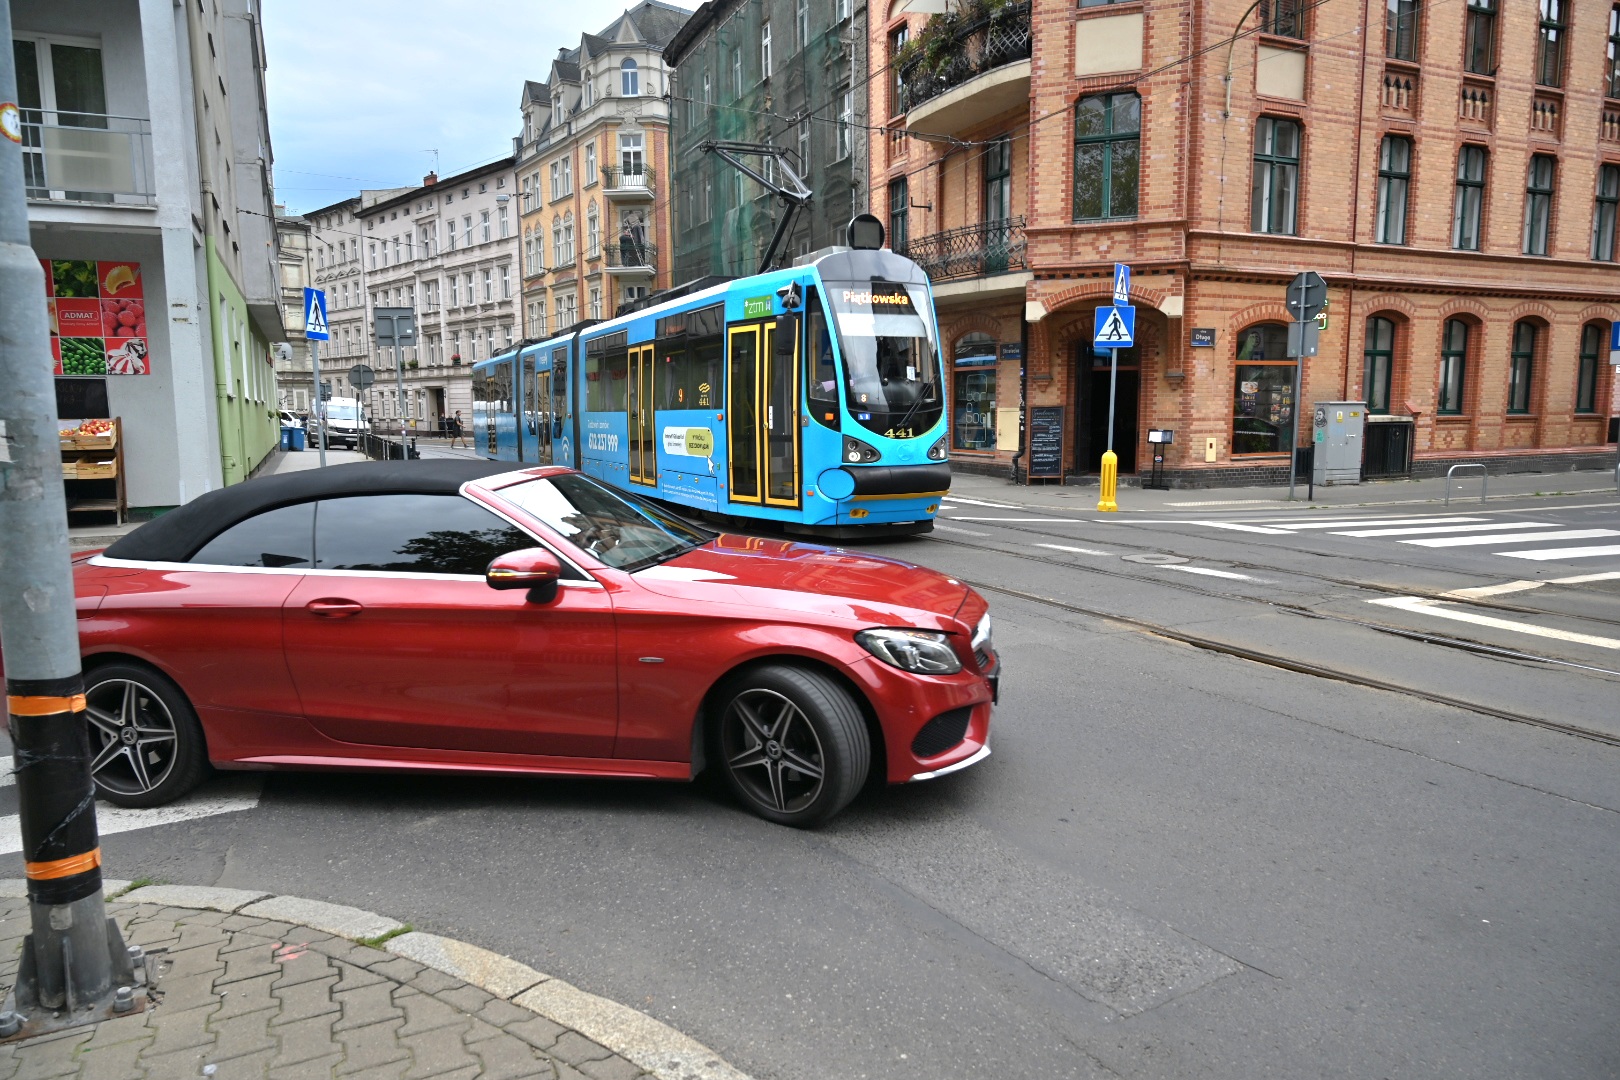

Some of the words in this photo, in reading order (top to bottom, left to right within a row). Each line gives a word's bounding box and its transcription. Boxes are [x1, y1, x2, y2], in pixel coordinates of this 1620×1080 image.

[678, 388, 683, 403] 9
[698, 397, 710, 406] 441
[883, 427, 915, 439] 441
